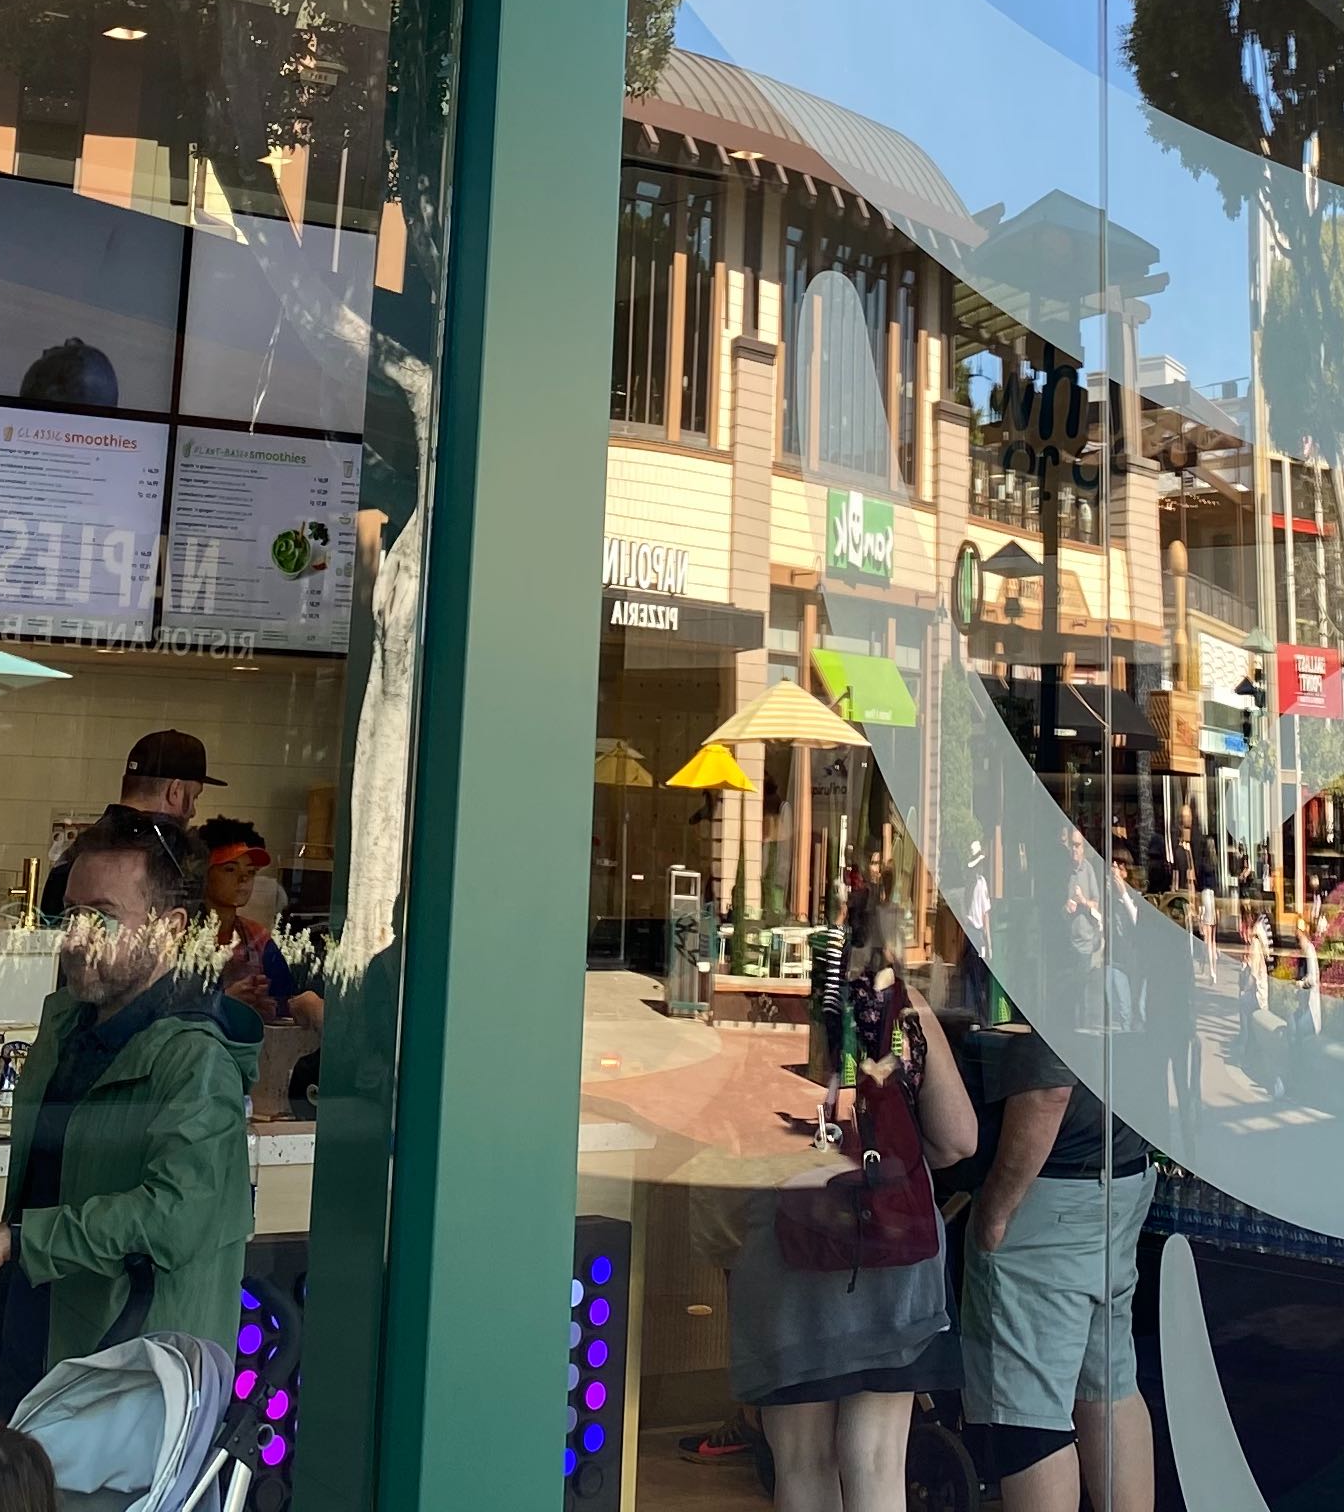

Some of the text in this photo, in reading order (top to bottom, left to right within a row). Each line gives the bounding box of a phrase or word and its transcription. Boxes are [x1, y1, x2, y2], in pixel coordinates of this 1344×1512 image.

[16, 426, 138, 449] CLASSIC smoothies
[248, 450, 307, 464] smoothies
